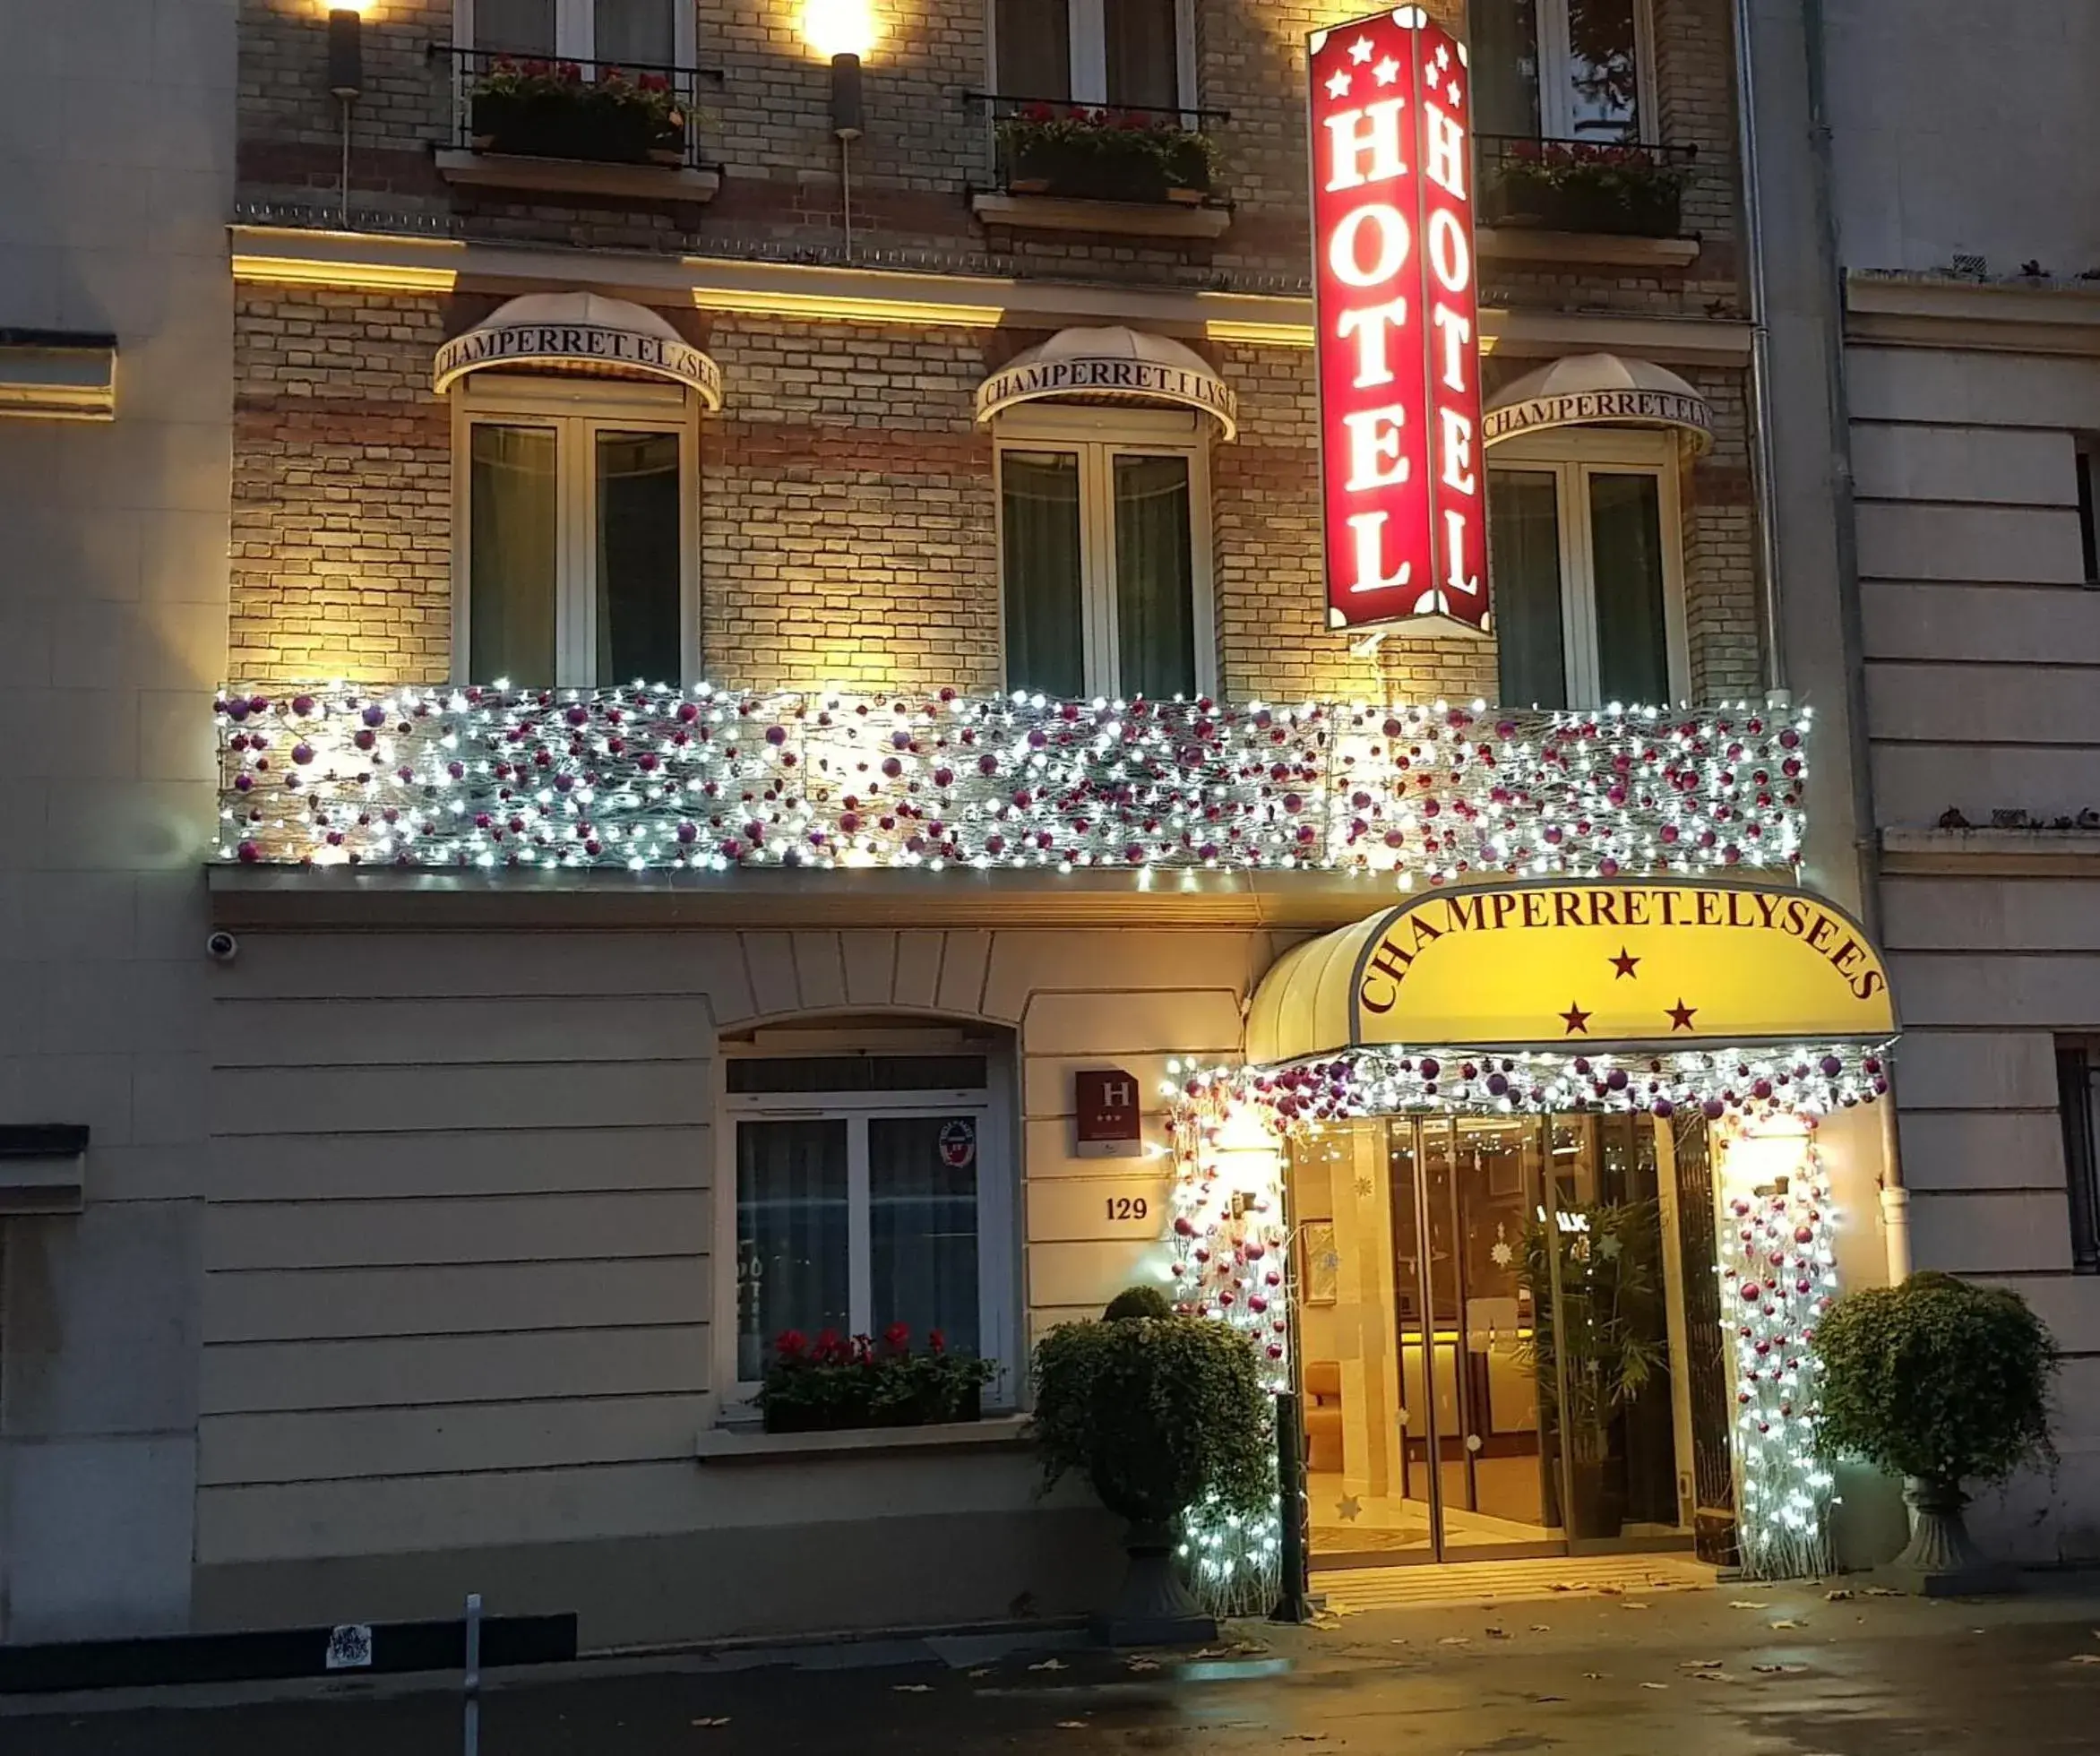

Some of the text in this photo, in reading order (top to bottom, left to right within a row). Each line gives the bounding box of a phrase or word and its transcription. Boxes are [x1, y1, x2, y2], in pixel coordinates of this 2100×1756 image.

[1322, 98, 1411, 595] HOTEL
[1424, 100, 1478, 596] HOTEL
[1103, 1081, 1131, 1107] H
[1106, 1197, 1148, 1220] 129
